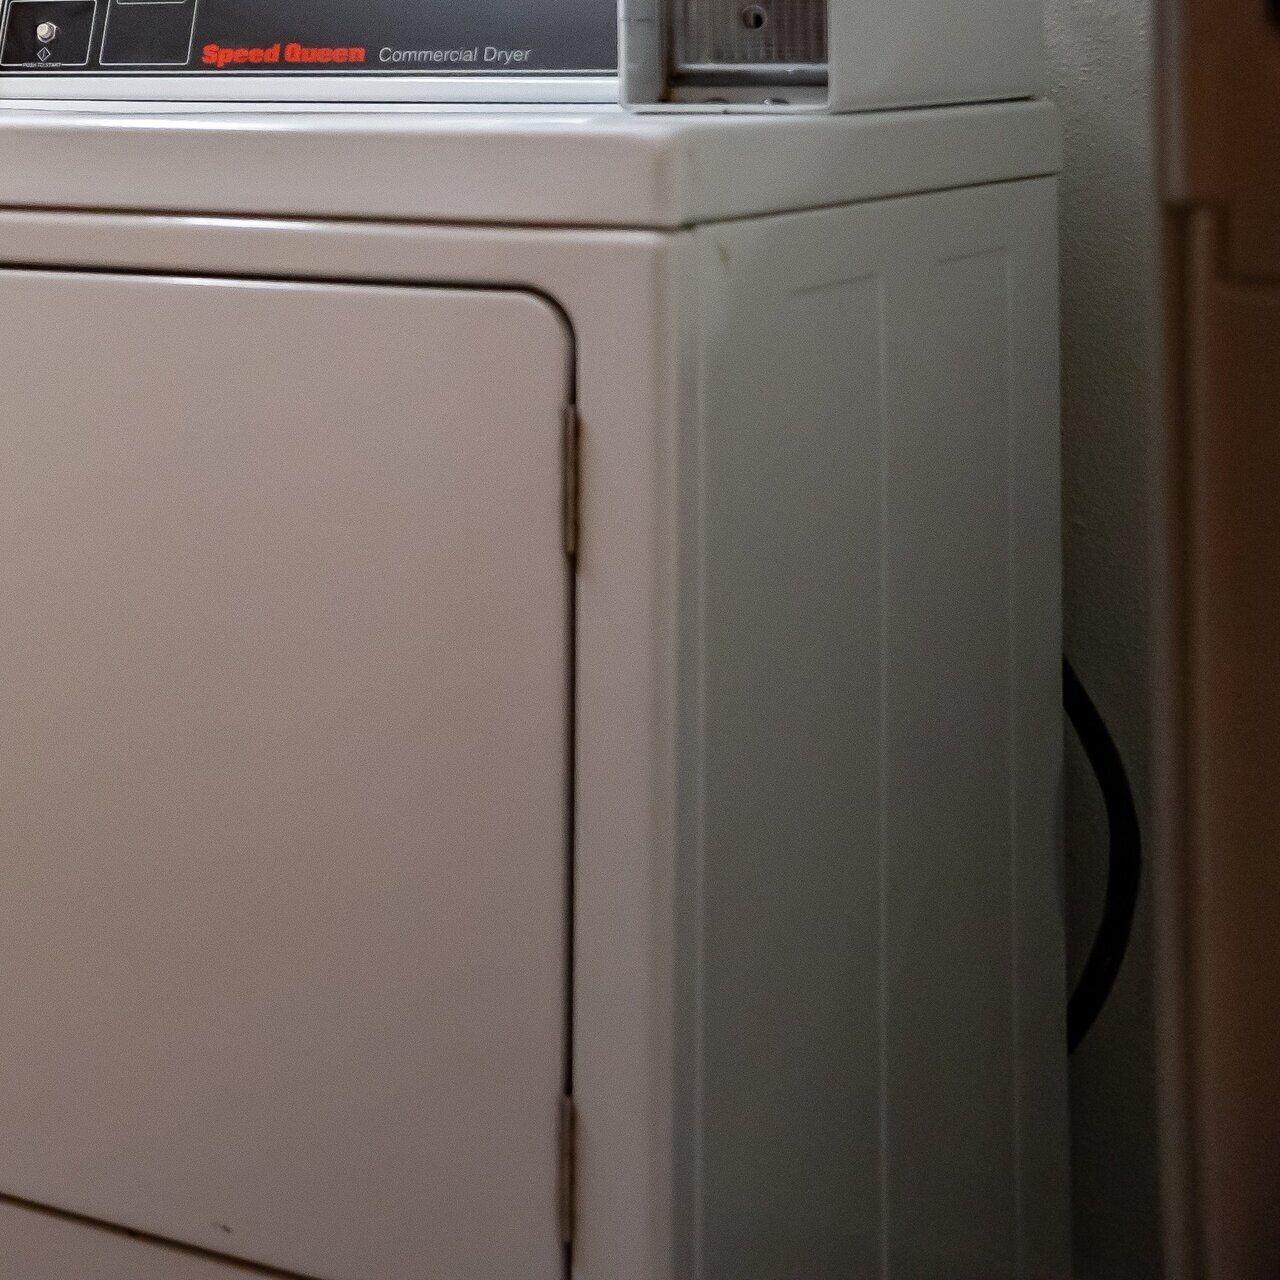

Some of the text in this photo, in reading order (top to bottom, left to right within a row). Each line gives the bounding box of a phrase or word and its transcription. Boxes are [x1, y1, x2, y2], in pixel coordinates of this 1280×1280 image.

[202, 42, 533, 68] Speed Queen Commercial Dryer
